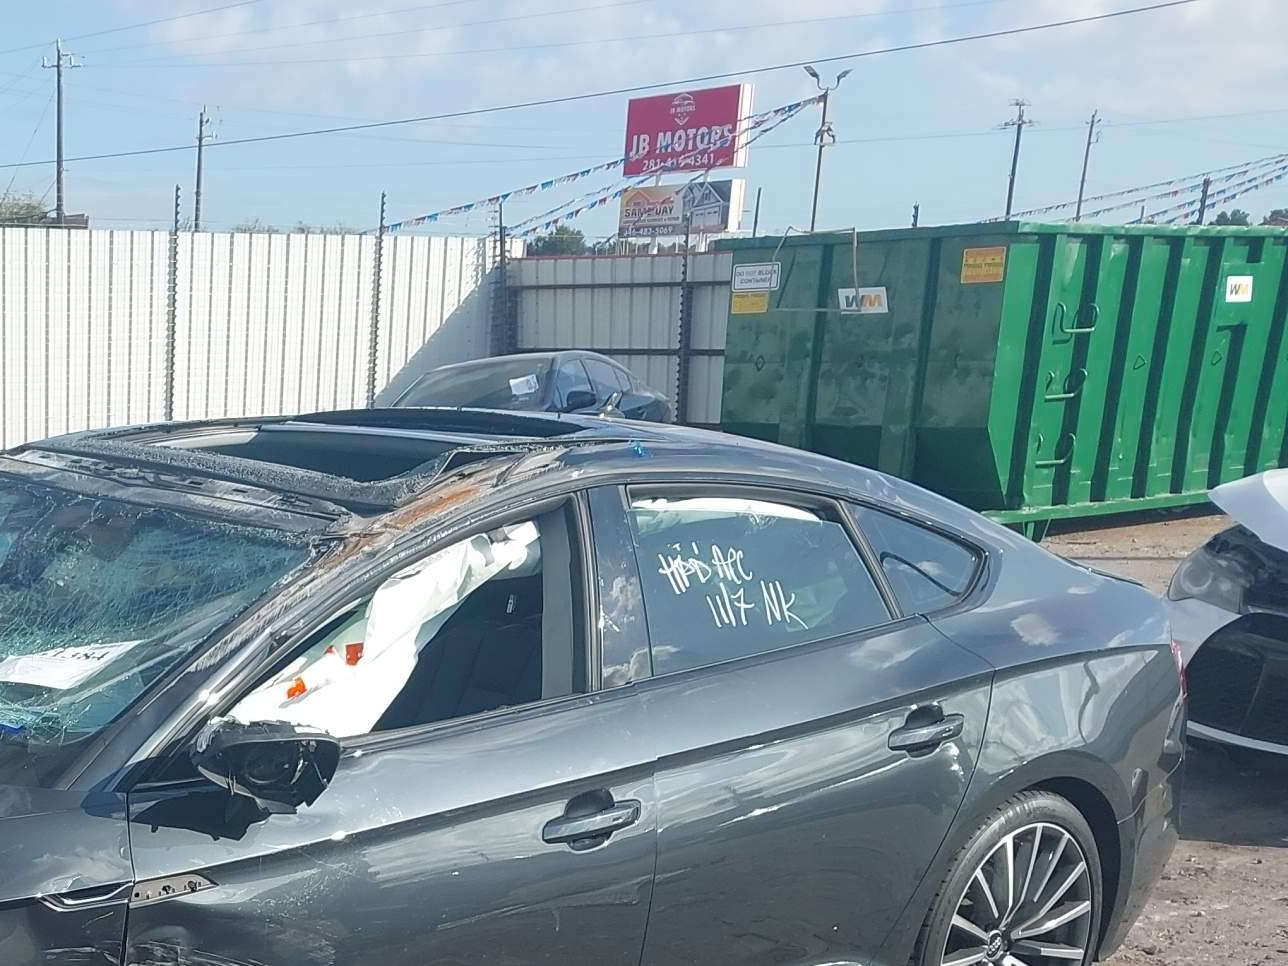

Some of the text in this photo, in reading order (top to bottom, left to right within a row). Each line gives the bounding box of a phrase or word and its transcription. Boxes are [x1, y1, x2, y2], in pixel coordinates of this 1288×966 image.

[629, 124, 733, 159] JB MOTORS
[1229, 283, 1250, 296] WM
[844, 294, 883, 309] WM
